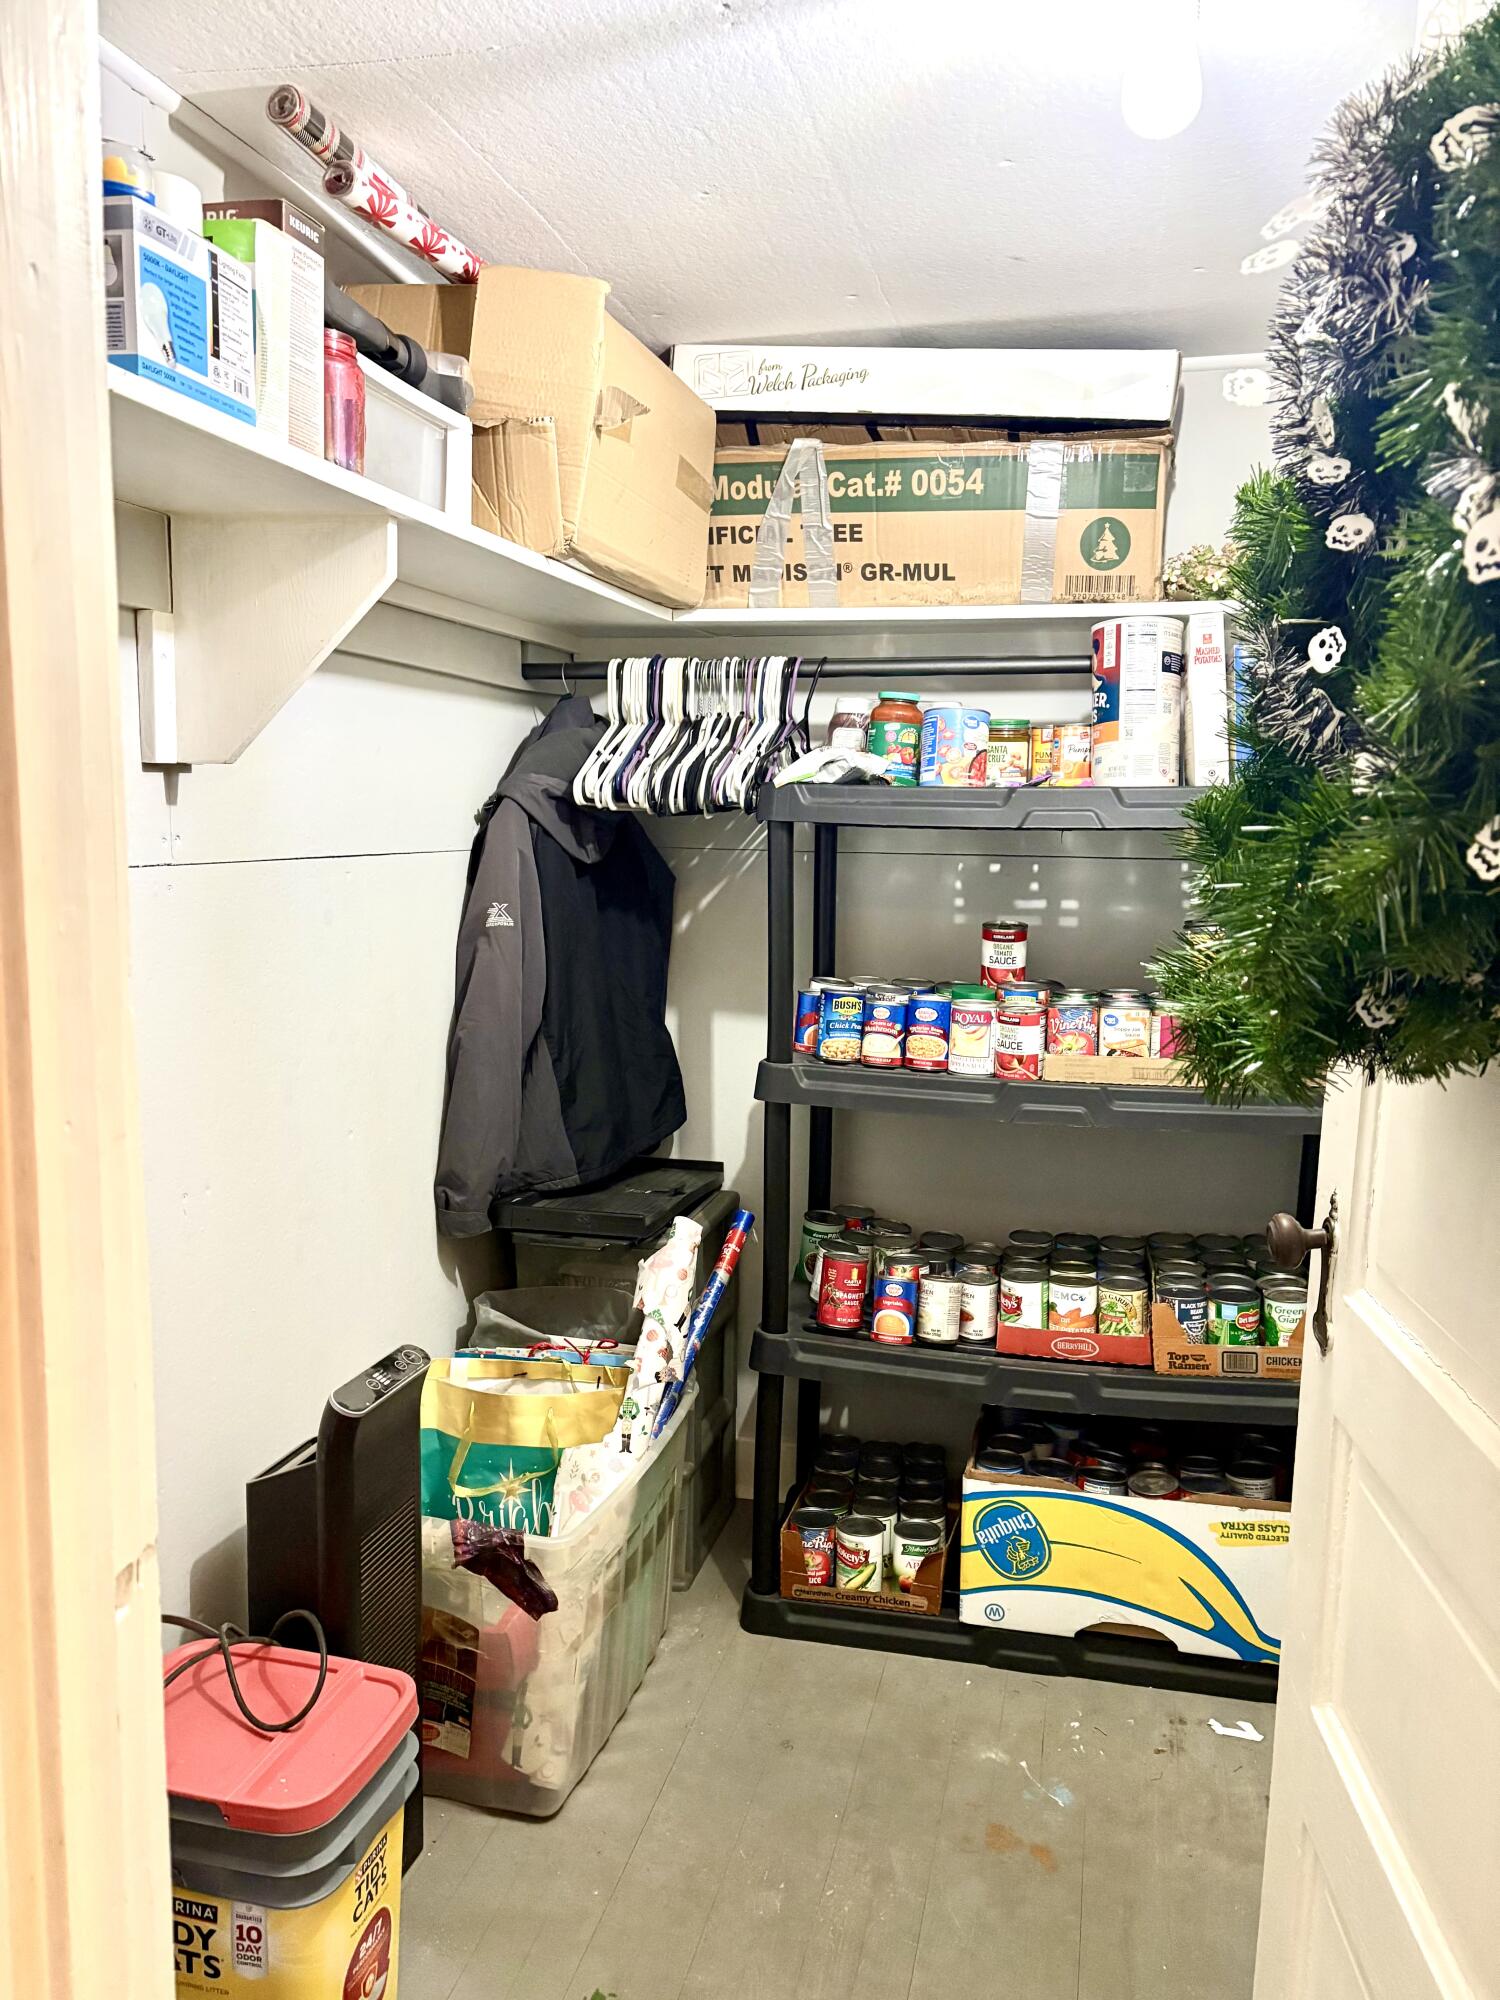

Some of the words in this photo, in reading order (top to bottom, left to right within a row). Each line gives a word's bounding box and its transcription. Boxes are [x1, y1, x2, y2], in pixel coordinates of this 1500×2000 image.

[289, 214, 320, 243] KEURIG
[165, 263, 189, 282] DAYLIGHT
[758, 359, 783, 375] from
[748, 372, 796, 395] Welch
[801, 363, 869, 390] Packaging
[828, 470, 901, 497] Cat.#
[911, 468, 984, 496] 0054
[861, 562, 956, 582] GR-MUL
[1196, 646, 1220, 656] MASHED
[1194, 655, 1222, 665] POTATOES
[989, 955, 1017, 965] SAUCE
[834, 1000, 862, 1011] BUSH'S
[955, 1012, 987, 1025] ROYAL
[829, 1021, 849, 1030] Chick
[1050, 1018, 1076, 1034] Vine
[997, 1042, 1022, 1051] SAUCE
[1275, 1305, 1304, 1315] Green
[1057, 1341, 1093, 1352] BERRYHILL
[1167, 1352, 1190, 1362] Top
[1168, 1360, 1210, 1371] Ramen
[976, 1511, 1037, 1546] Chiquita
[1221, 1521, 1255, 1532] EXTRA
[1258, 1524, 1290, 1534] CLASS
[1220, 1532, 1254, 1541] QUALITY
[835, 1593, 871, 1604] Creamy
[872, 1596, 911, 1607] Chicken
[363, 1838, 387, 1872] PURINA
[355, 1848, 387, 1900] TIDY
[353, 1866, 387, 1922] CATS
[175, 1900, 214, 1920] RINA
[174, 1920, 216, 1951] DY
[236, 1924, 262, 1944] 10
[359, 1917, 383, 1959] 24/7
[236, 1942, 262, 1954] DAY
[236, 1953, 262, 1963] ODOR
[236, 1960, 262, 1969] CONTROL
[205, 1985, 230, 1996] LITTER
